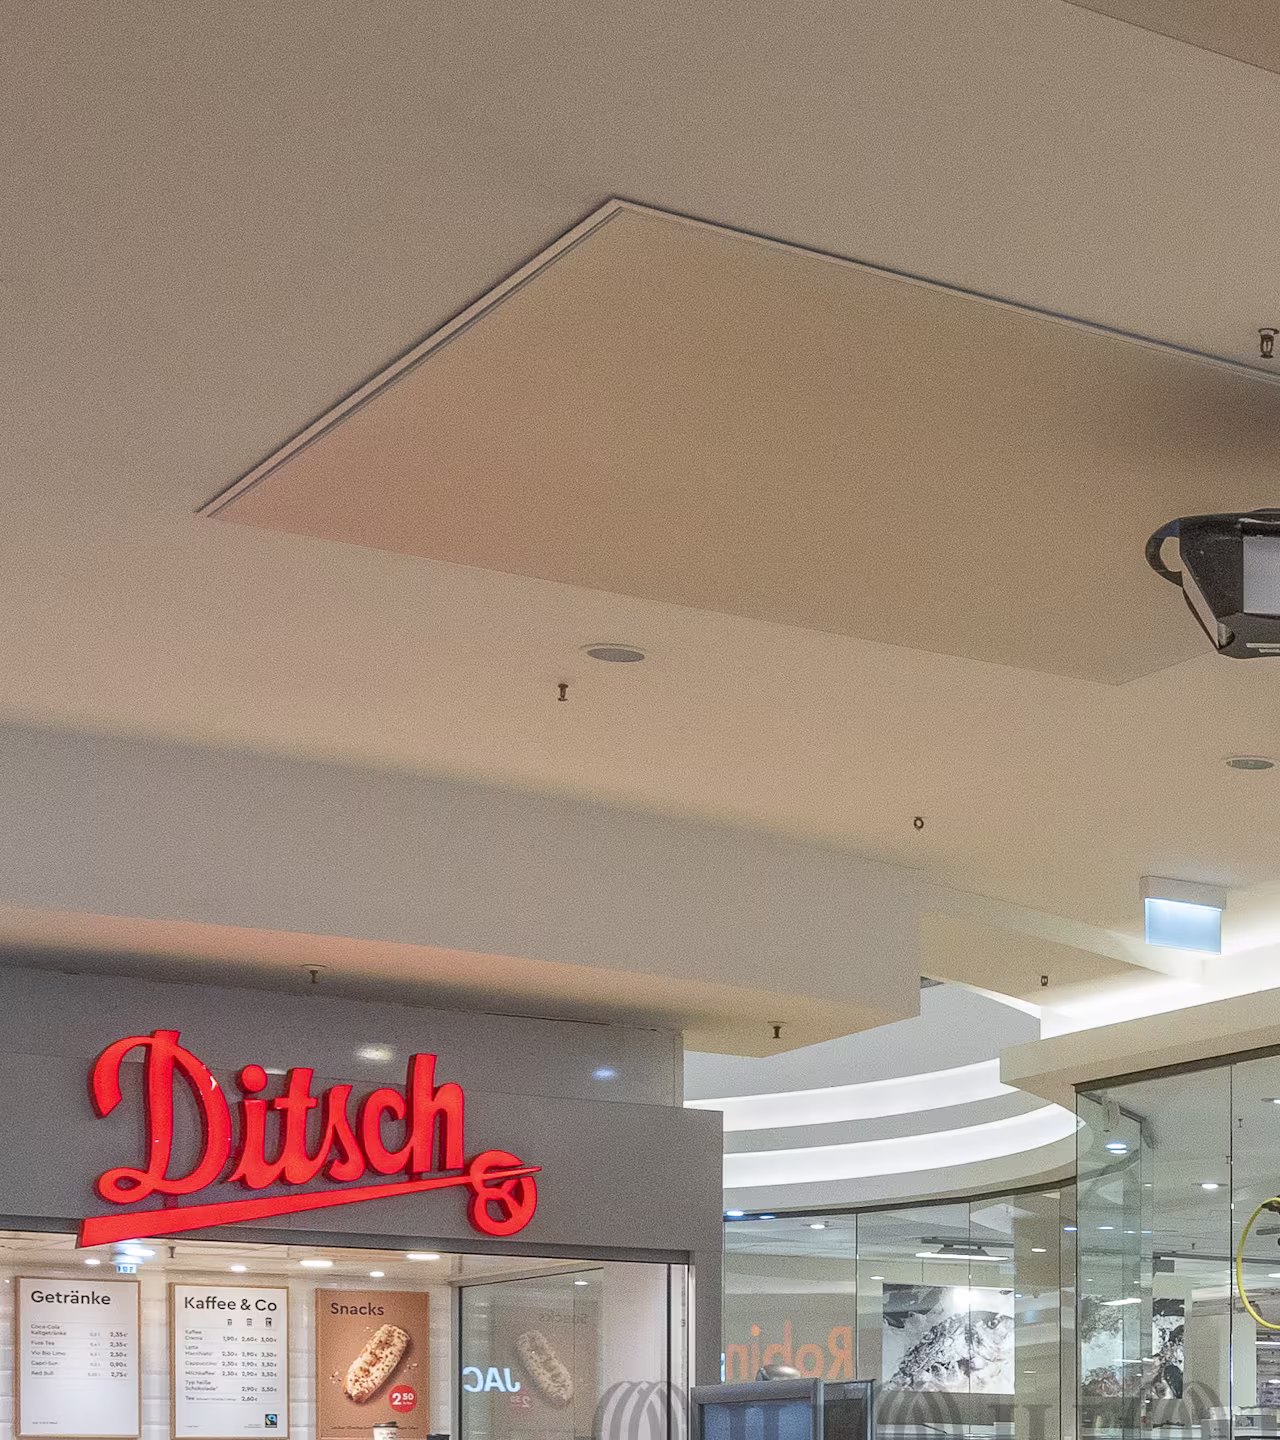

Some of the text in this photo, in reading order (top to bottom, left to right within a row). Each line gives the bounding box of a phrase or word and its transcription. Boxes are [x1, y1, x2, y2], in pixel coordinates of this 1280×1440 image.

[91, 1029, 467, 1206] Ditsch
[31, 1290, 111, 1305] Getränke
[184, 1296, 277, 1311] Kaffee & Co
[331, 1302, 384, 1316] Snacks
